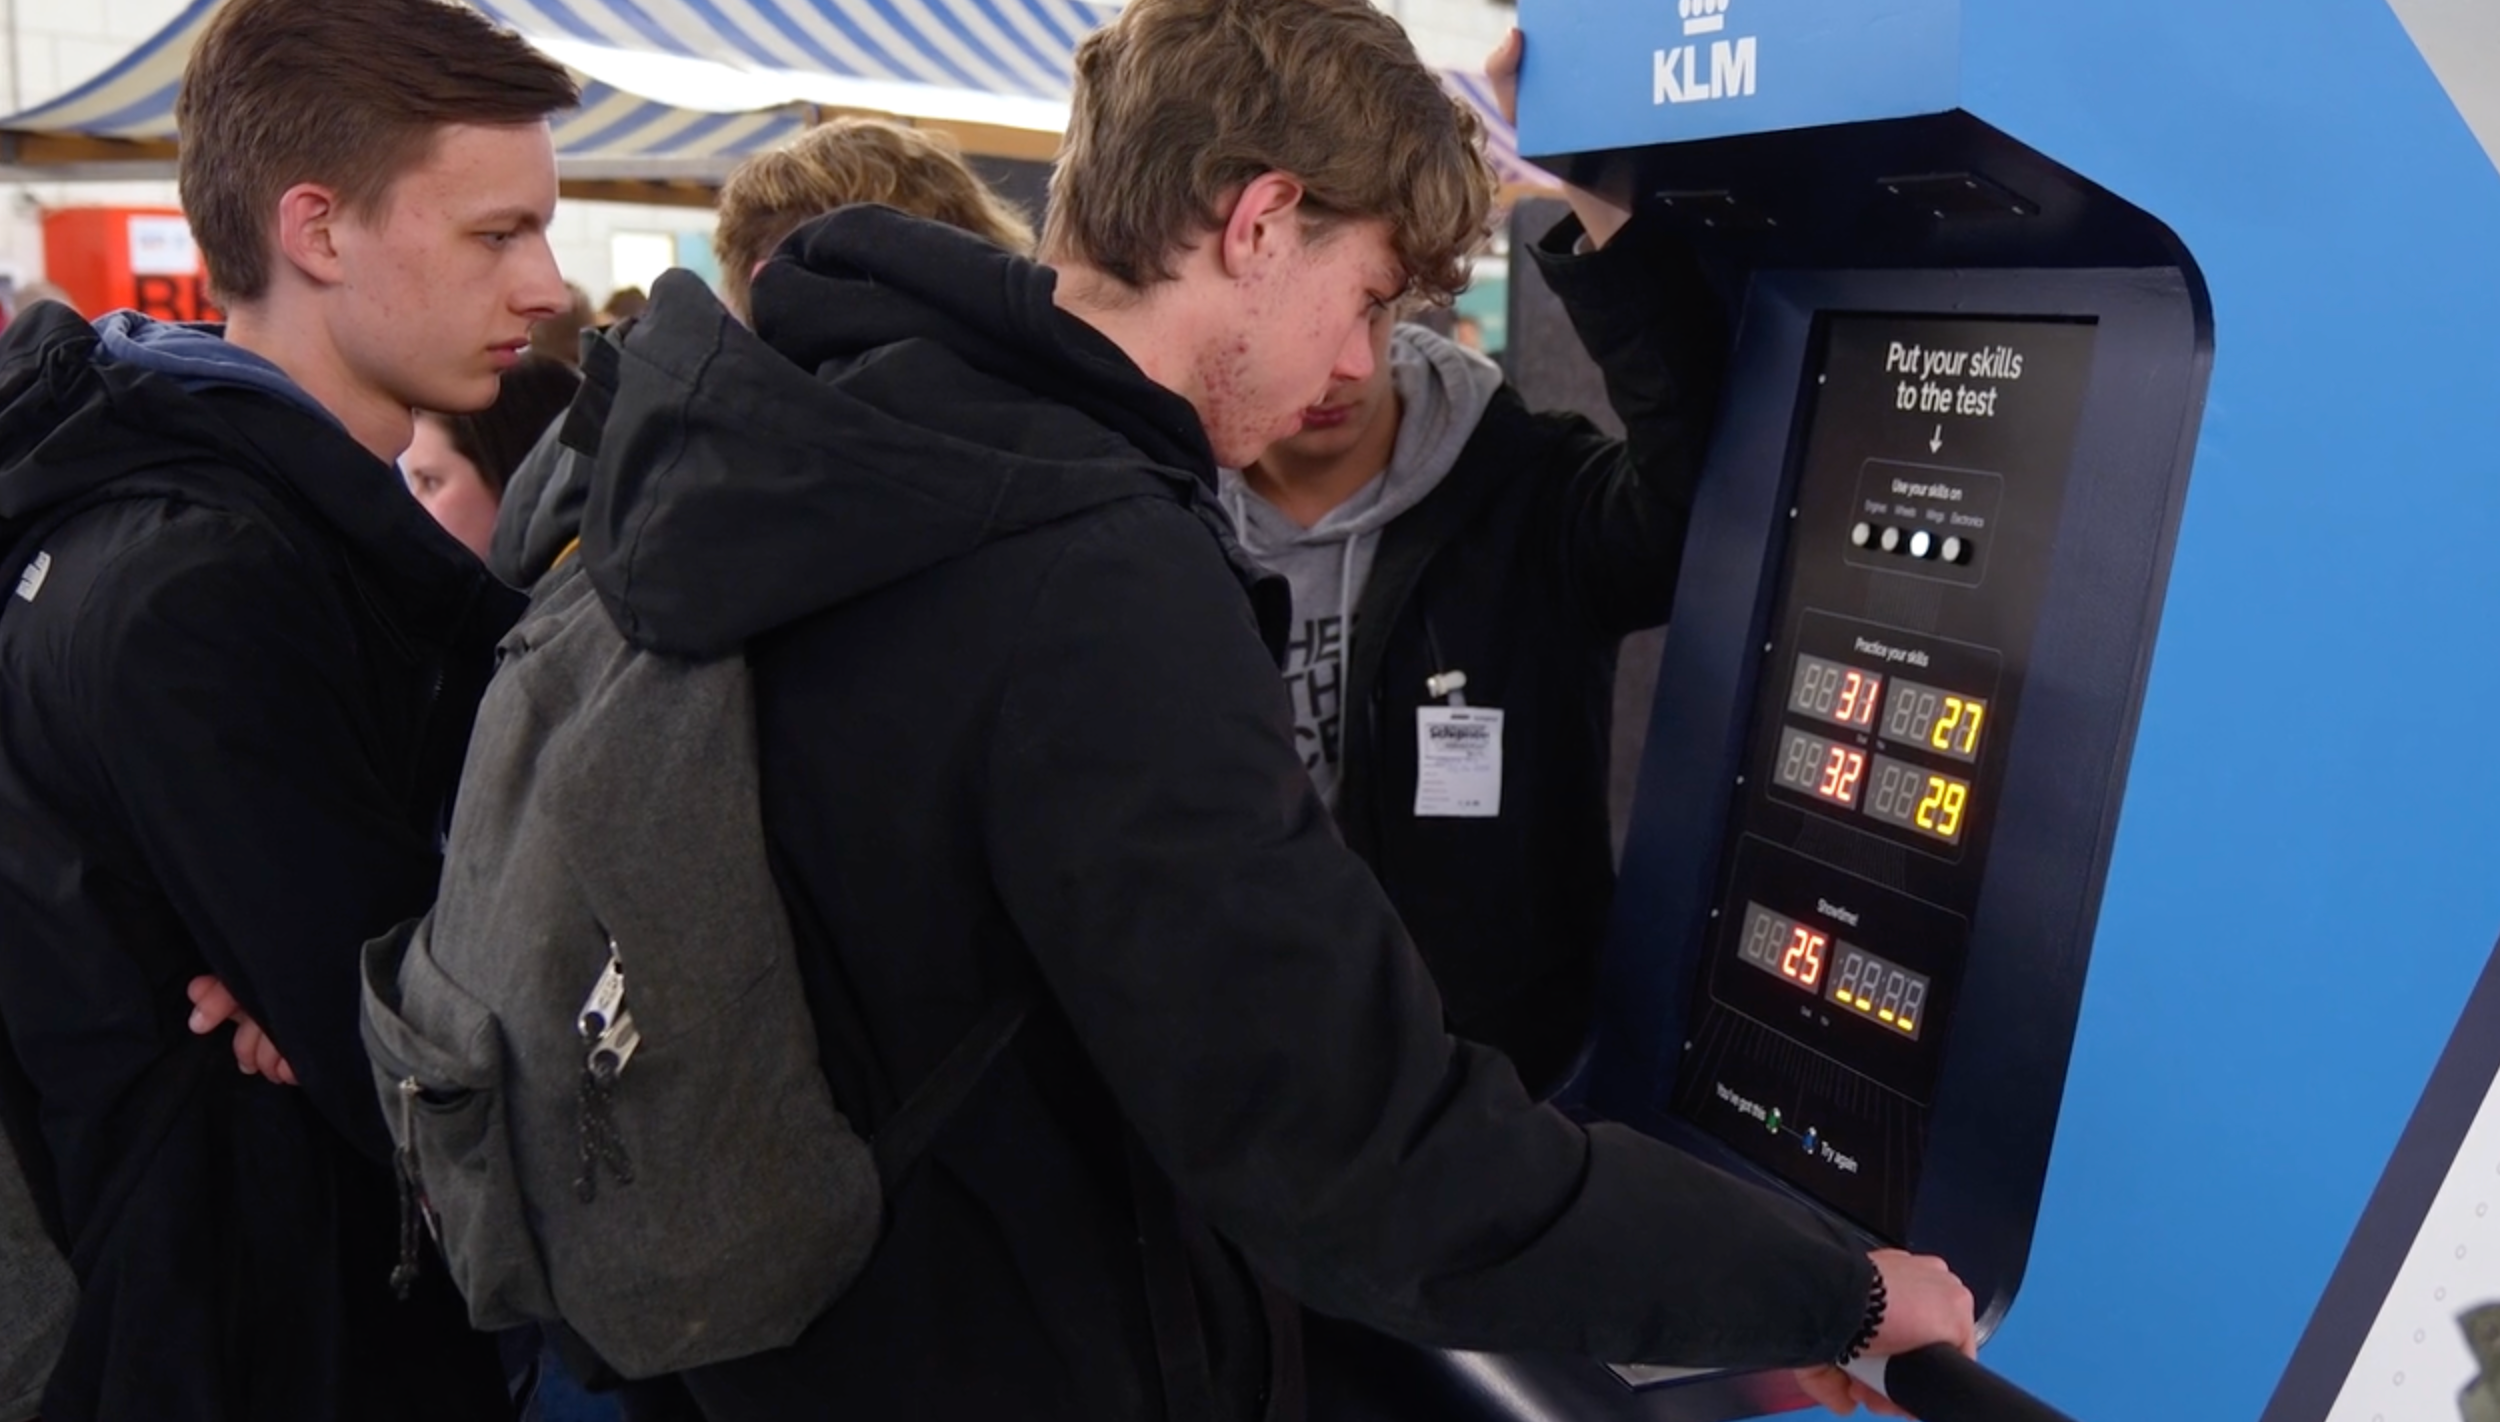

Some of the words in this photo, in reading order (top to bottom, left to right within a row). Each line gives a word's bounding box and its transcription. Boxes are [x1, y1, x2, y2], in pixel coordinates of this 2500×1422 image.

[1653, 36, 1757, 105] KLM
[1886, 341, 1921, 374] Put
[1919, 349, 1968, 381] your
[1969, 346, 2024, 379] skills
[1896, 381, 1917, 411] to
[1919, 382, 1952, 414] the
[1954, 385, 1998, 417] test
[1891, 478, 1909, 494] Use
[1907, 483, 1928, 498] your
[1928, 483, 1949, 500] skills
[1949, 488, 1963, 501] on
[1854, 636, 1887, 658] Practice
[1886, 647, 1907, 662] your
[1906, 649, 1929, 667] skills
[1931, 697, 1984, 753] 27
[1819, 747, 1863, 802] 32
[1915, 776, 1967, 836] 29
[1782, 926, 1825, 985] 25
[1821, 1140, 1836, 1163] Try
[1834, 1151, 1858, 1174] again
